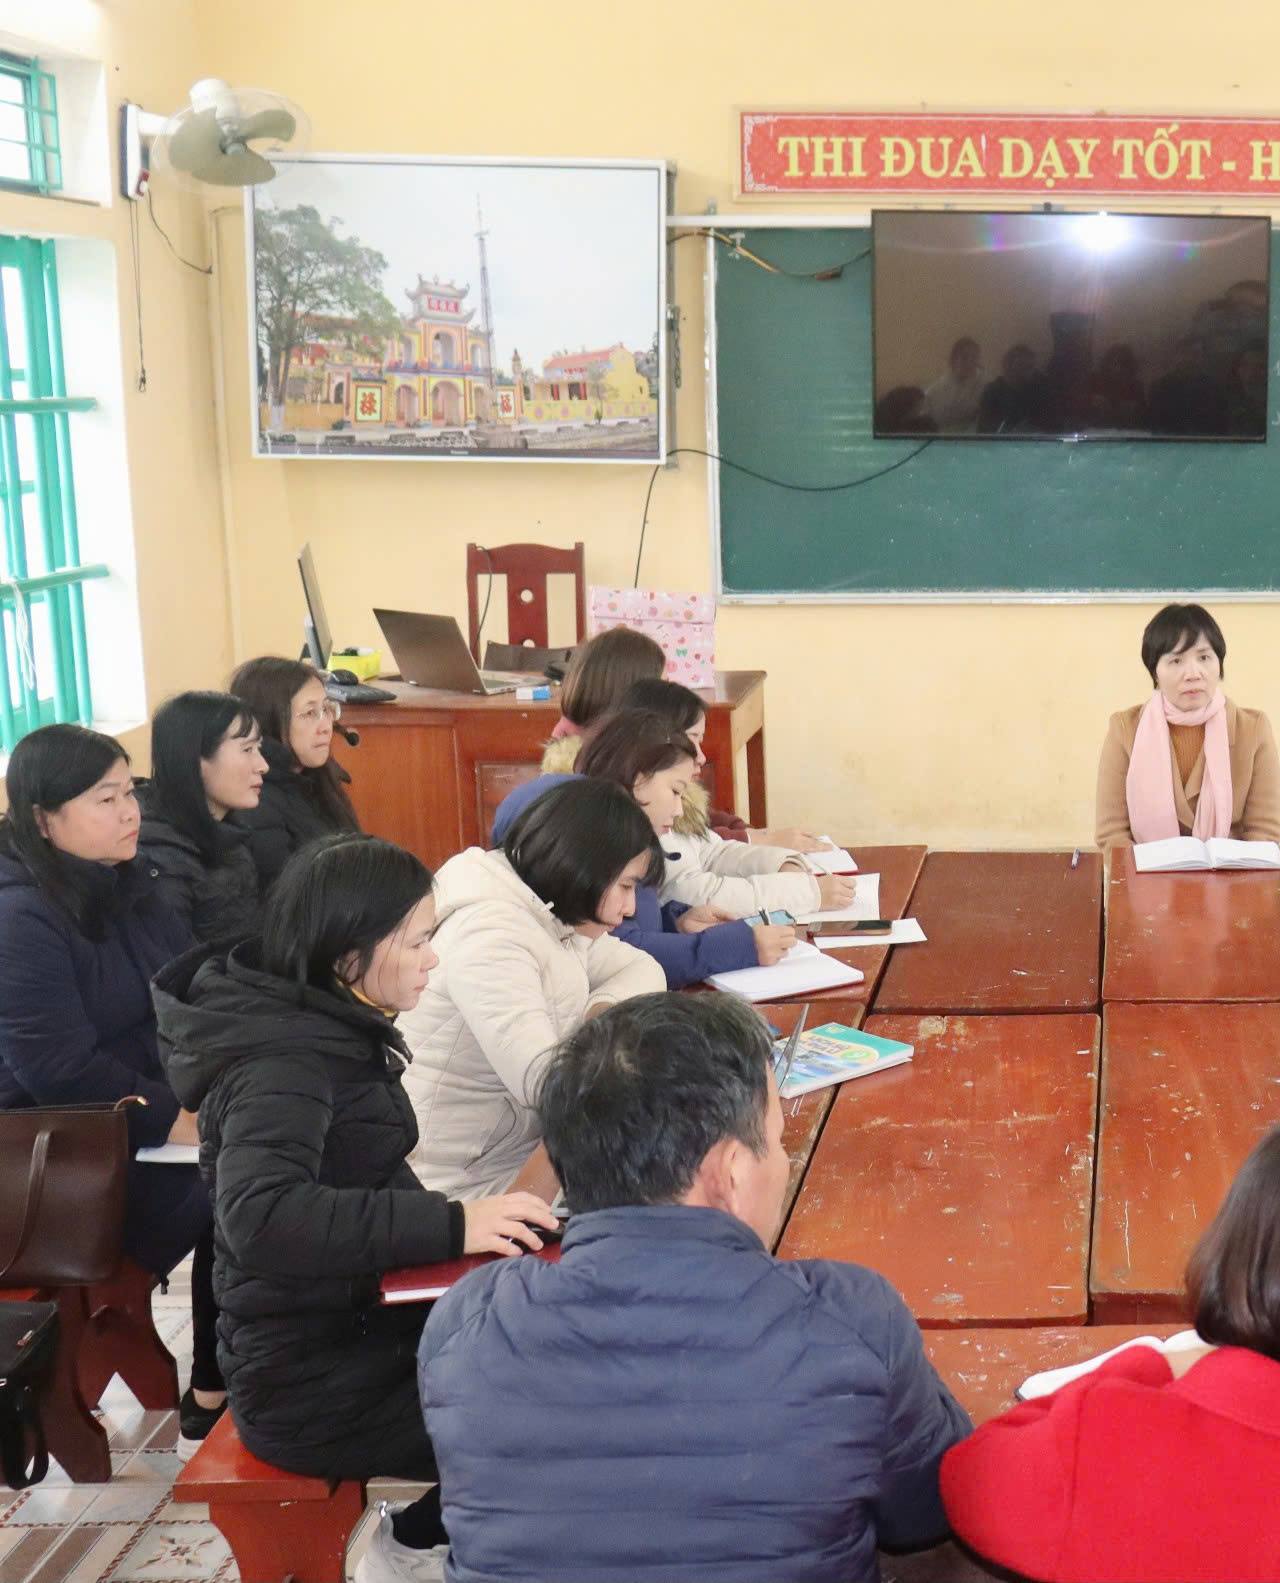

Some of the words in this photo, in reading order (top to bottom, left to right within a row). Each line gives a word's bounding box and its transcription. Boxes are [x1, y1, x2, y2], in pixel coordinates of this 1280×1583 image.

[777, 136, 866, 178] THI
[879, 136, 985, 178] ĐUA
[1000, 138, 1099, 188] DẠY
[1113, 123, 1211, 180] TỐT
[1222, 160, 1237, 171] -
